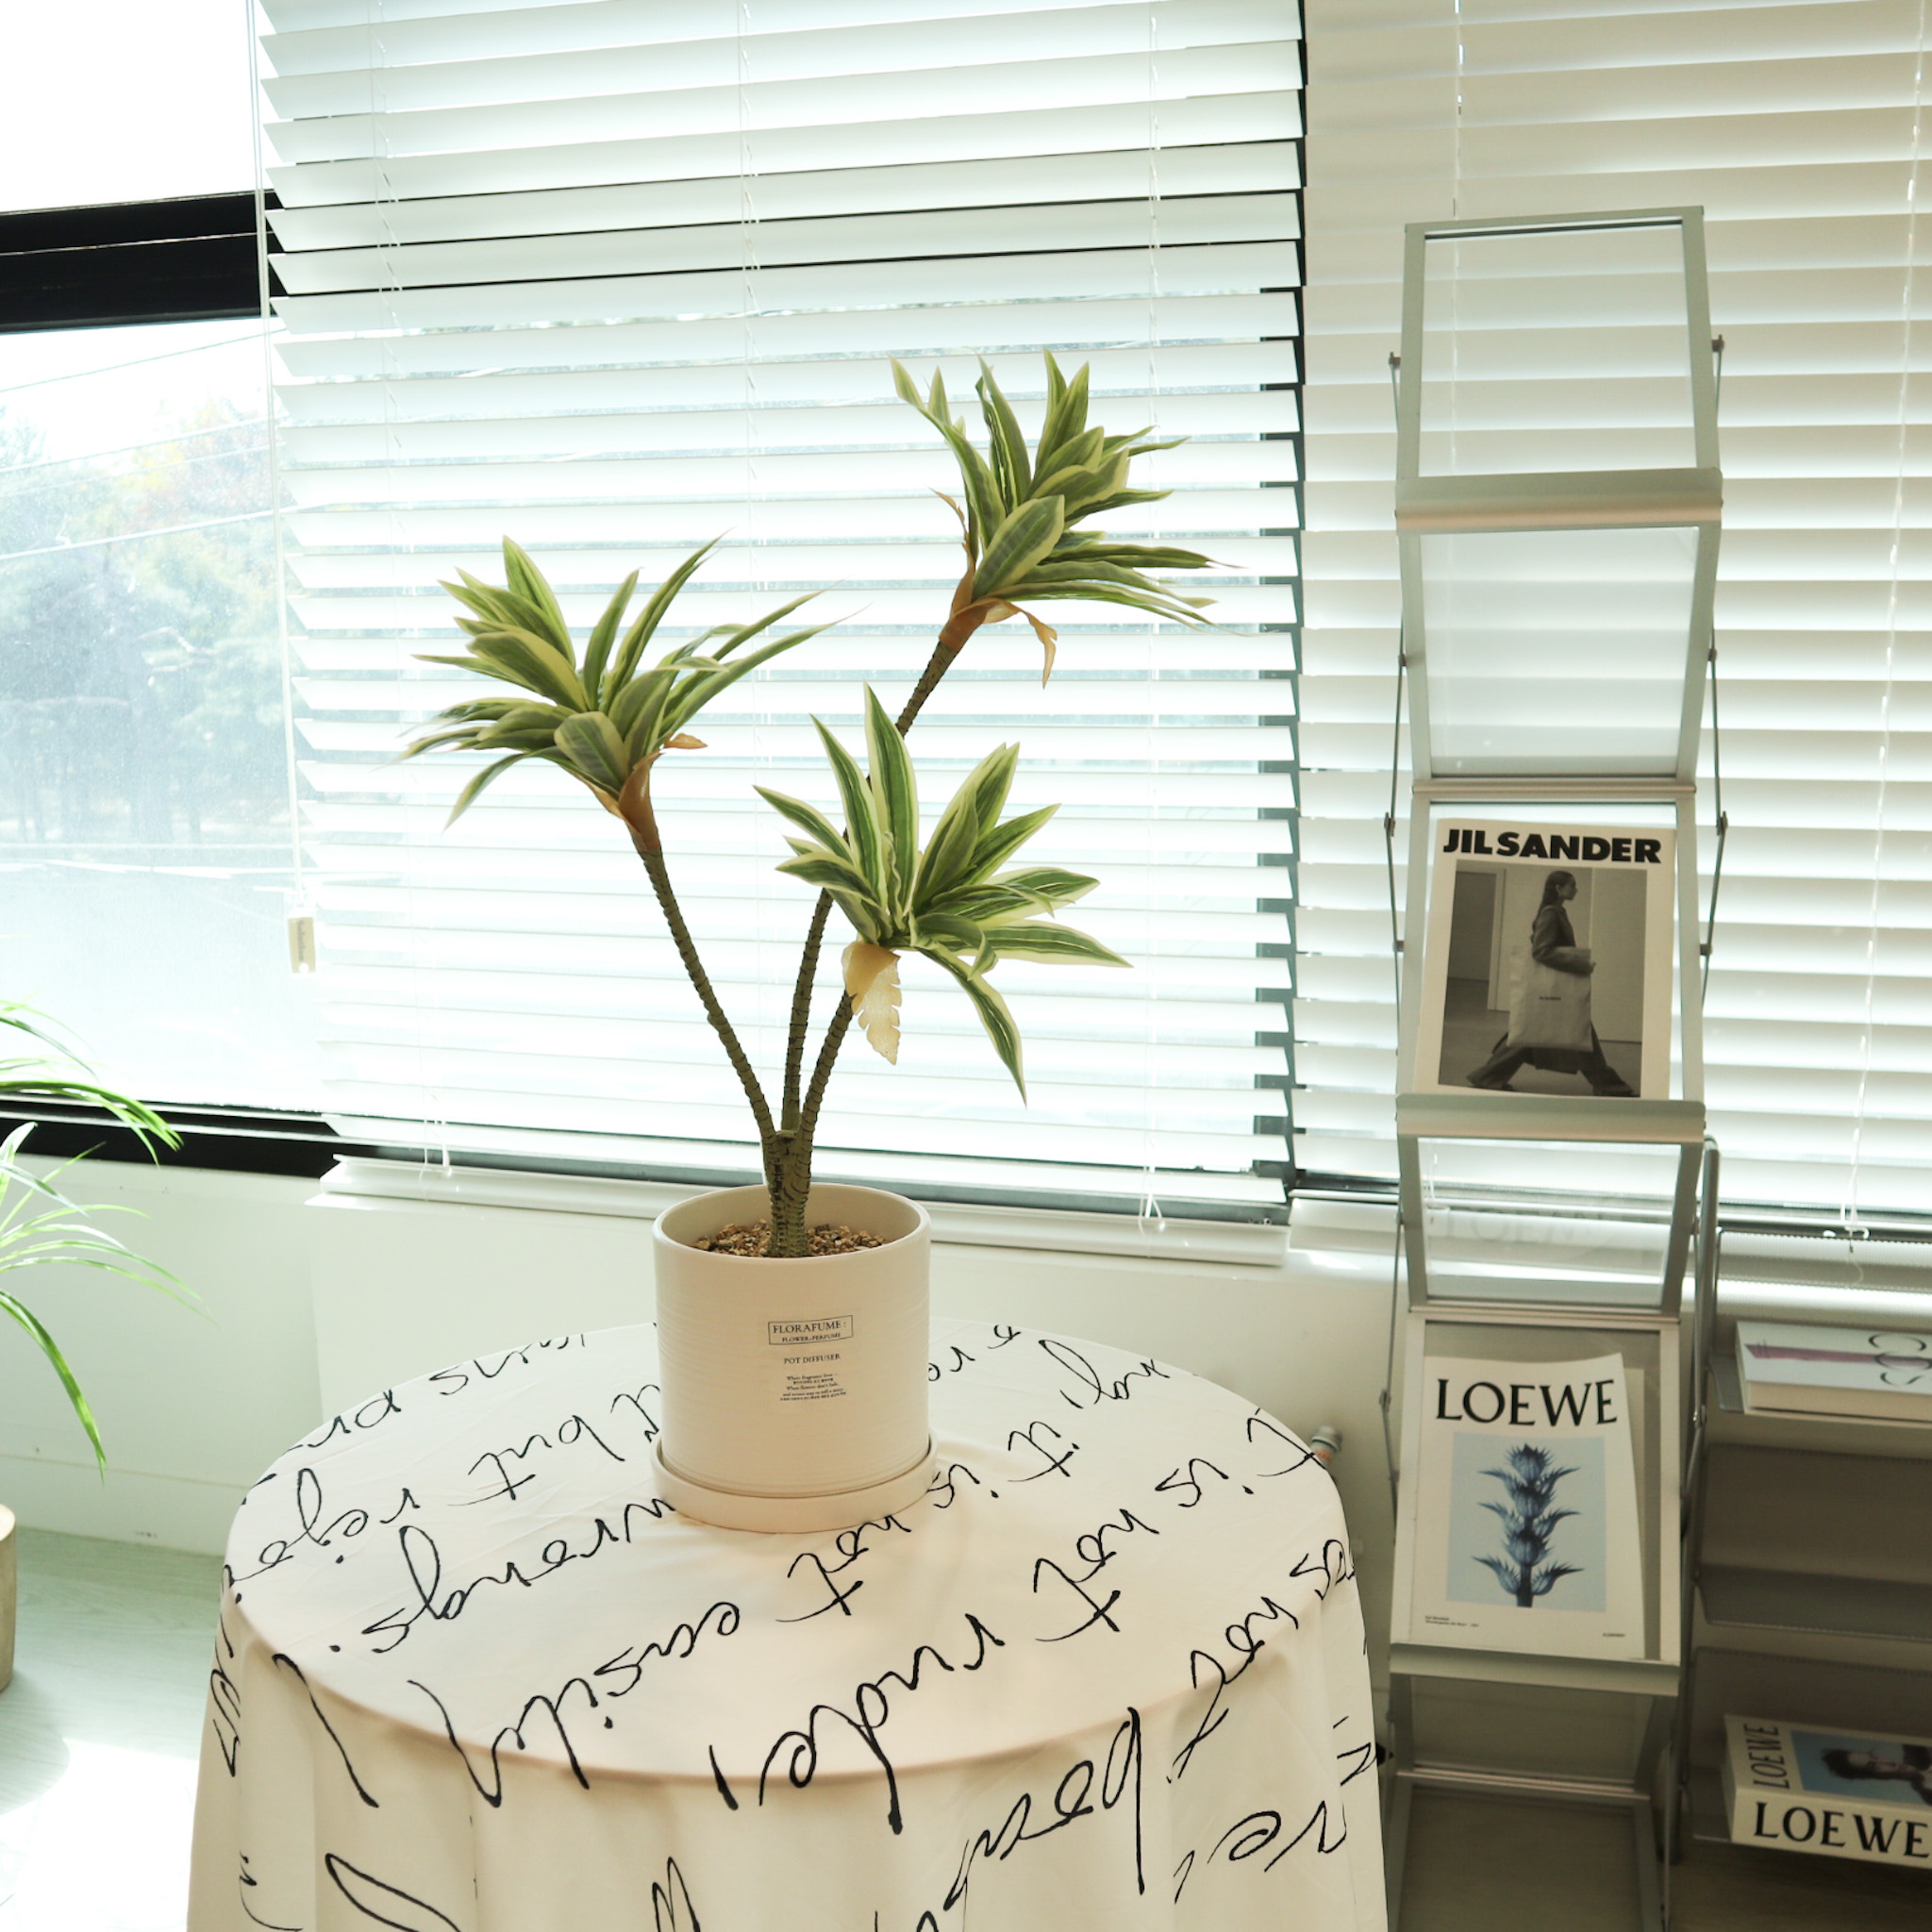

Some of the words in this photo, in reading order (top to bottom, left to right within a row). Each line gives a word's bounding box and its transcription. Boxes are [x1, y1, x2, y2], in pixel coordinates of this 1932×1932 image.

[1442, 829, 1492, 855] JIL
[1496, 831, 1662, 864] SANDER
[803, 1354, 841, 1364] DIFFUSER
[1435, 1376, 1618, 1426] LOEWE
[1155, 1458, 1254, 1507] is
[1033, 1508, 1159, 1641] not
[1747, 1724, 1790, 1790] LOEWE
[1754, 1802, 1931, 1859] LOEWE
